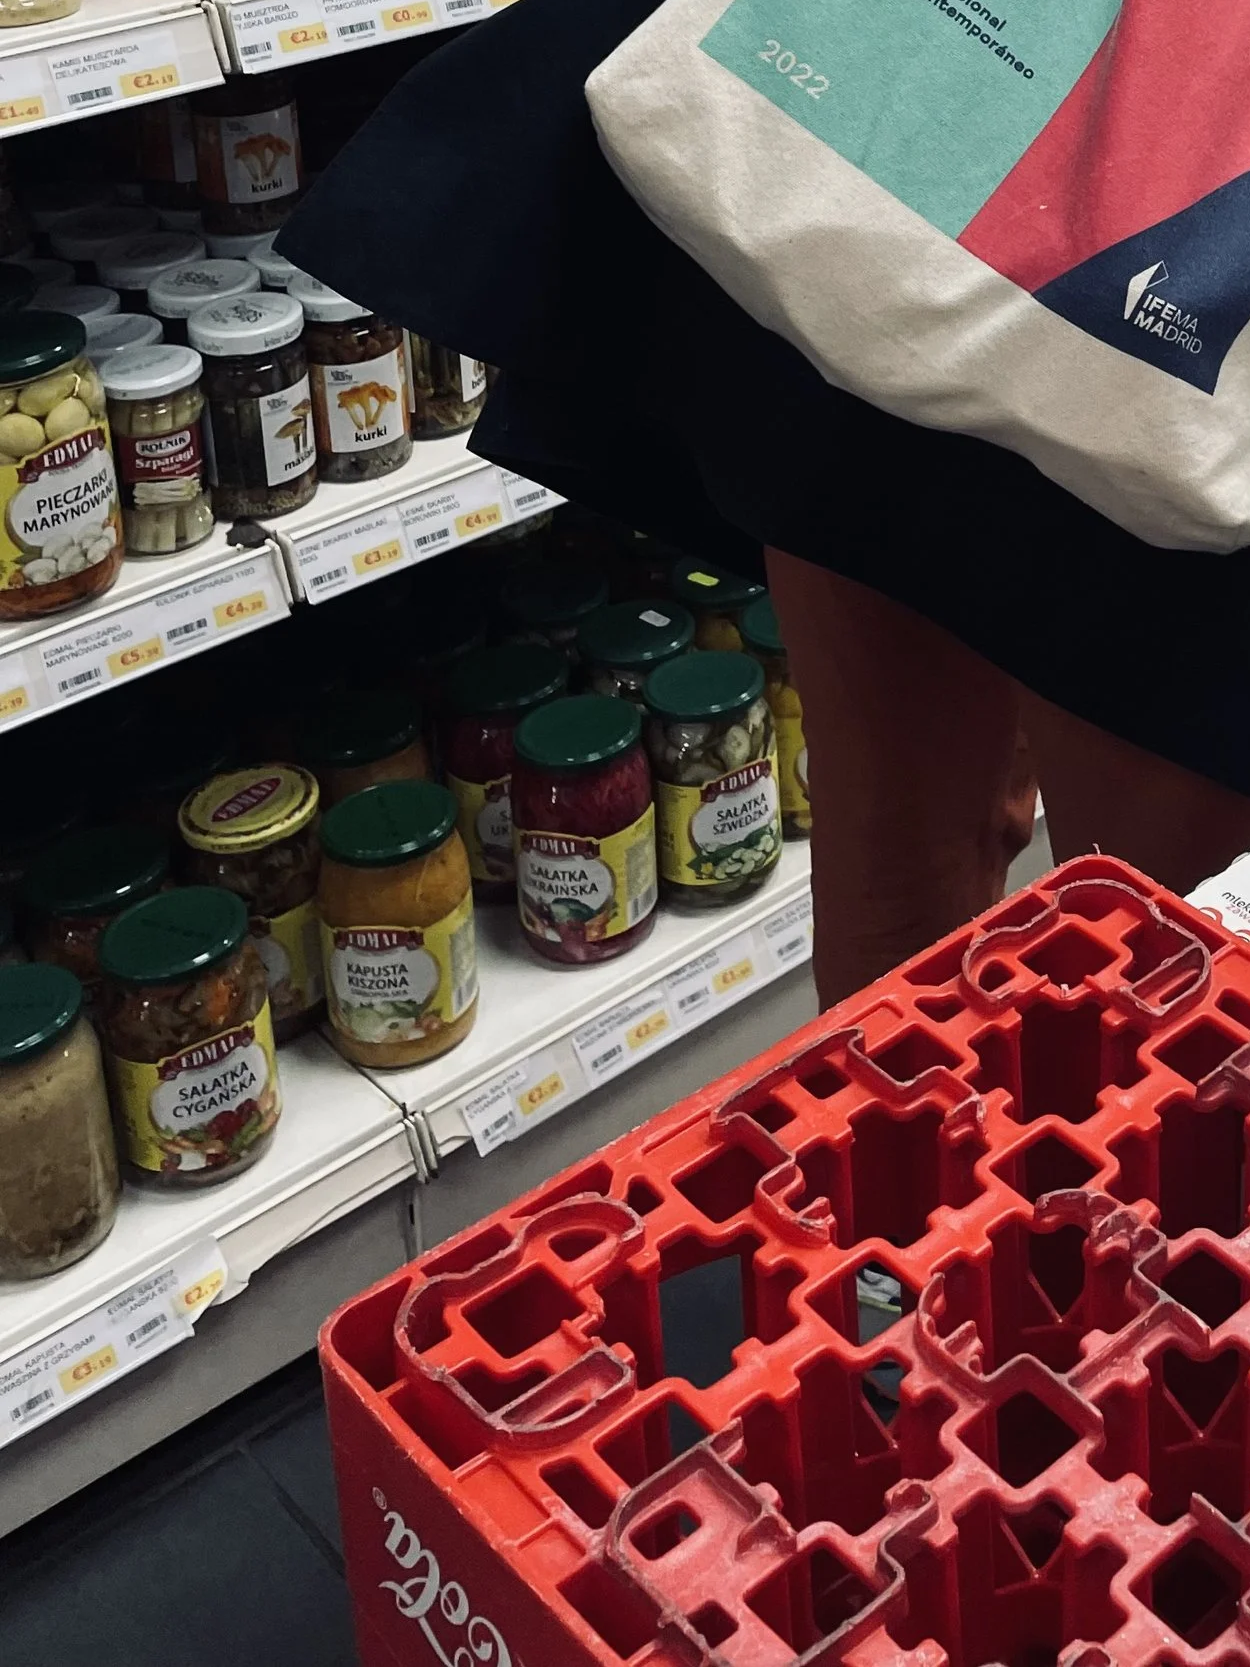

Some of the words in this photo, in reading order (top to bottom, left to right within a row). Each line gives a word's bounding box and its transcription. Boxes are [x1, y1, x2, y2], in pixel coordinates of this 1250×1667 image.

[266, 10, 298, 24] BARDZO
[83, 44, 139, 64] MUSZTARDA
[55, 57, 128, 80] DELIKATESOWA
[758, 39, 832, 100] 2022
[251, 178, 283, 194] kurki
[1142, 294, 1198, 333] IFEMA
[1133, 310, 1202, 354] MADRID
[138, 436, 189, 453] ROLNIK
[354, 426, 388, 444] kurki
[134, 447, 195, 469] Szparagi
[36, 469, 109, 514] PIECZARKI
[716, 792, 767, 823] SAŁATKA
[712, 804, 769, 836] SZWEDZKA
[529, 863, 588, 882] SAŁATKA
[346, 963, 408, 977] KAPUSTA
[347, 976, 409, 991] KISZONA
[178, 1062, 251, 1103] SAŁATKA
[172, 1072, 259, 1119] CYGAŃSKA
